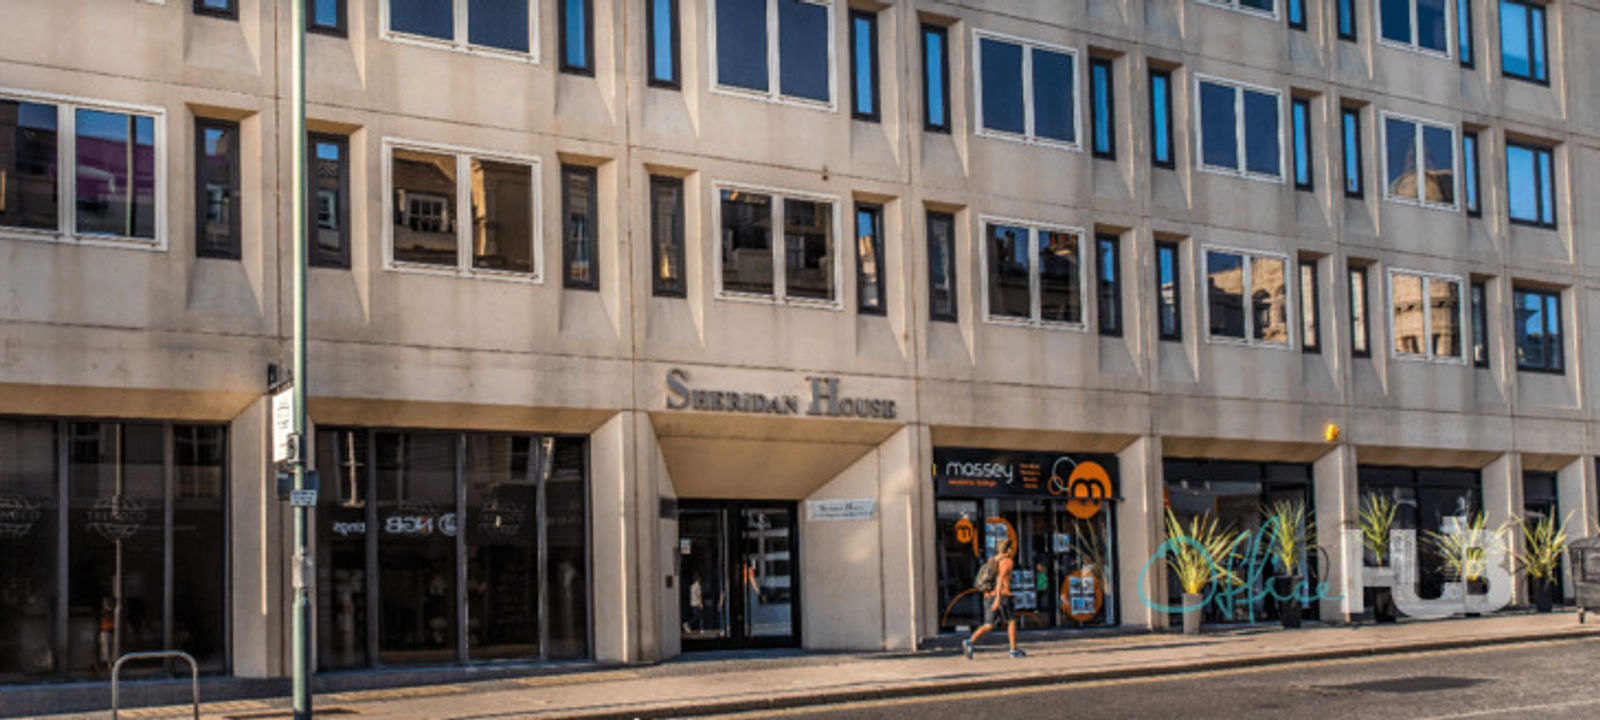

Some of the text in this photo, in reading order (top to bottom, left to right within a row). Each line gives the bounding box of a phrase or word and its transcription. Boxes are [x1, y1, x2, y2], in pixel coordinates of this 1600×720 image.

[665, 368, 897, 419] SHERIDAN HOUSE
[945, 462, 1013, 484] massey
